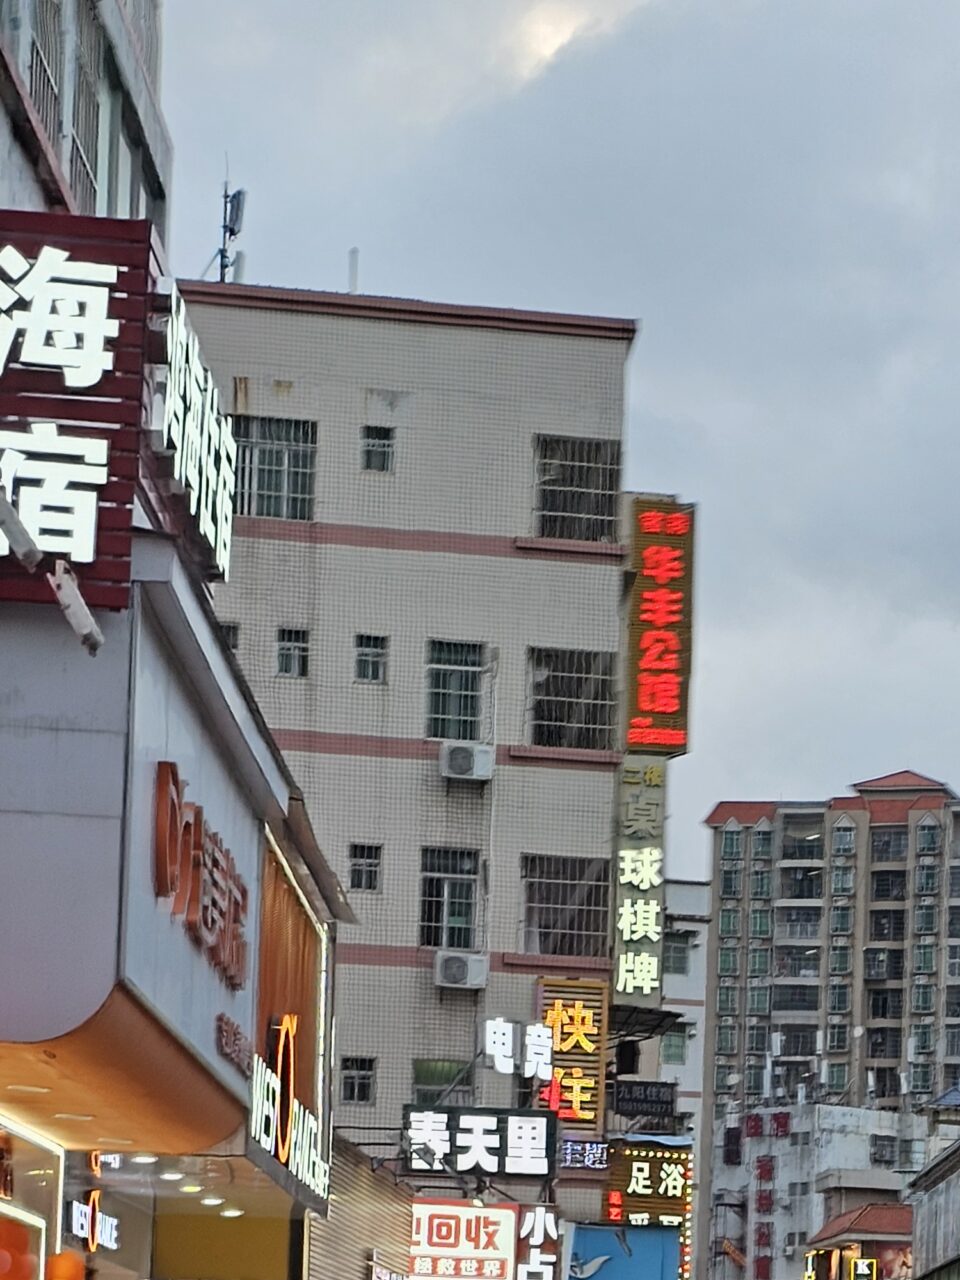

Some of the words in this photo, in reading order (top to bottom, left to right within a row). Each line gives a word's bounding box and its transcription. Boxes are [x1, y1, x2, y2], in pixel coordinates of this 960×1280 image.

[486, 1017, 553, 1080] 电竞
[627, 1161, 686, 1197] 足浴
[410, 1213, 501, 1251] 回收
